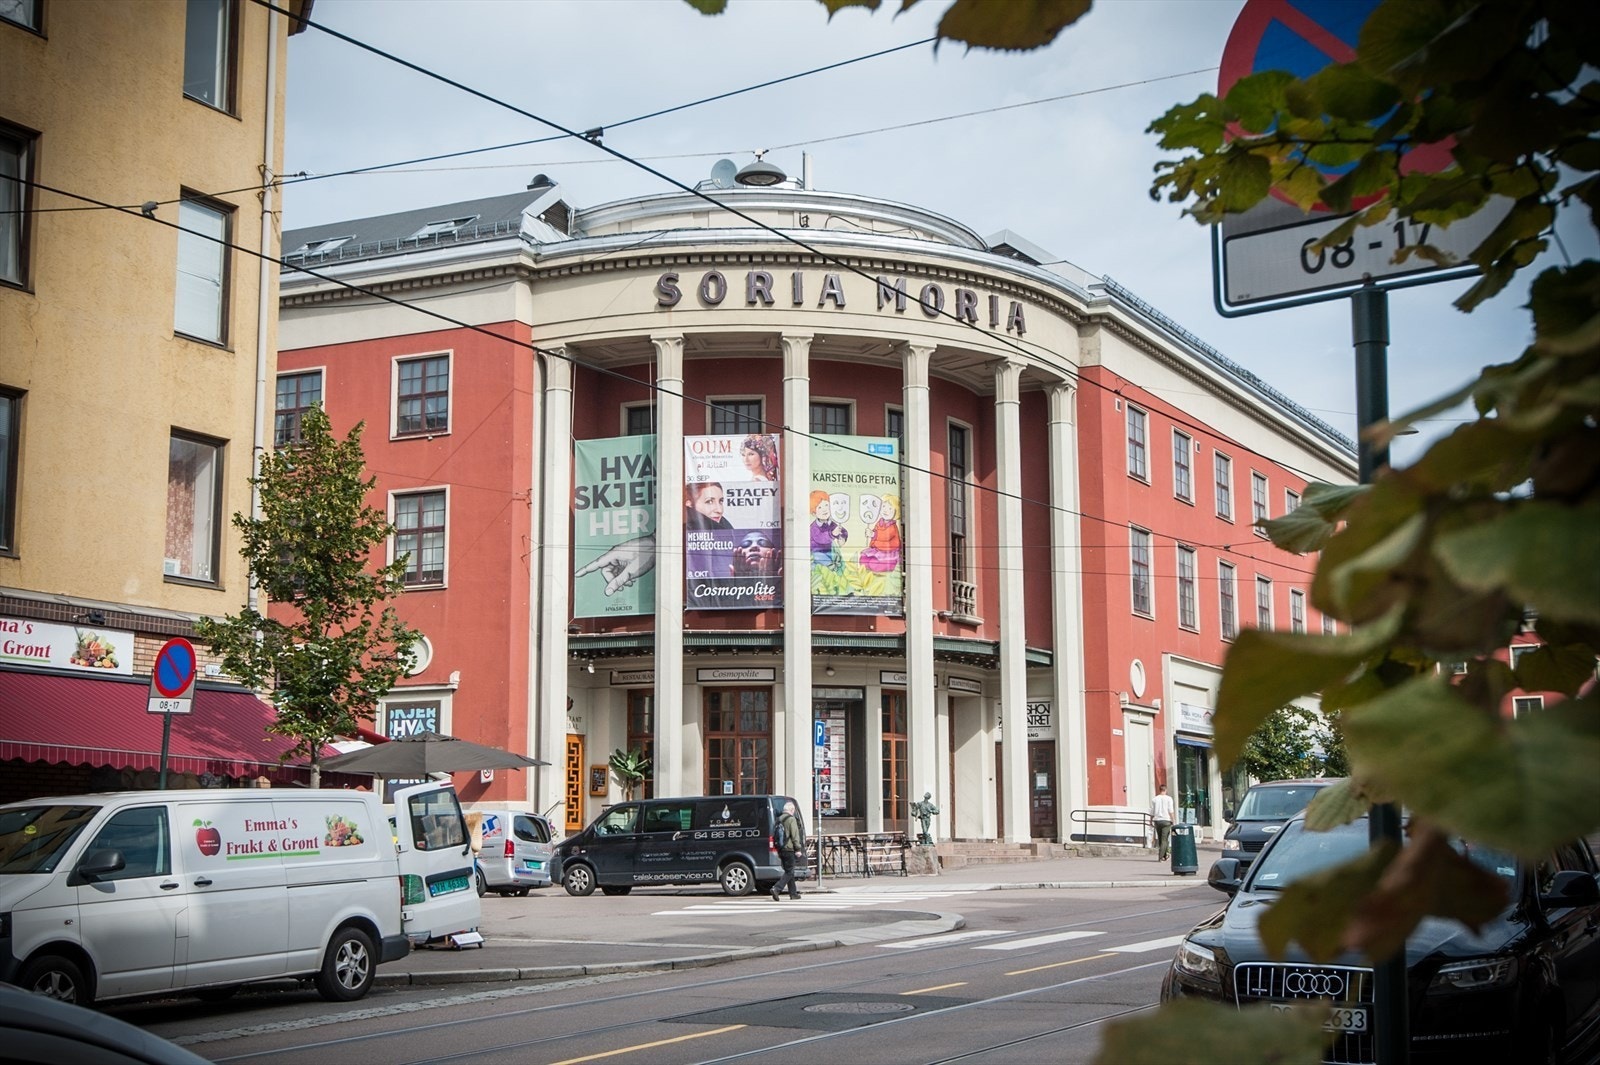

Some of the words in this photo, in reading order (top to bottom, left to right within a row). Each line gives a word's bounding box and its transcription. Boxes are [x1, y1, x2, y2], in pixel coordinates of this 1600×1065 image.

[657, 270, 846, 307] SORIA
[877, 275, 1028, 334] MORIA
[692, 440, 732, 454] OUM
[601, 454, 656, 481] HVA
[812, 473, 853, 483] KARSTEN
[855, 474, 868, 483] OG
[869, 475, 897, 485] PETRA
[726, 488, 778, 498] STACEY
[727, 497, 763, 507] KENT
[589, 508, 650, 537] HER
[687, 541, 733, 551] NDEGEOCELLO
[694, 581, 776, 600] Cosmopolite
[3, 640, 52, 658] Grønt
[622, 673, 655, 681] RESTAURAN
[712, 668, 760, 681] Cosmopolite
[244, 817, 298, 832] Emma's
[694, 831, 708, 839] 64
[711, 830, 725, 839] 86
[728, 830, 743, 838] 80
[745, 829, 760, 837] 00
[226, 839, 264, 855] Frukt
[267, 838, 278, 852] &
[282, 836, 319, 851] Grønt
